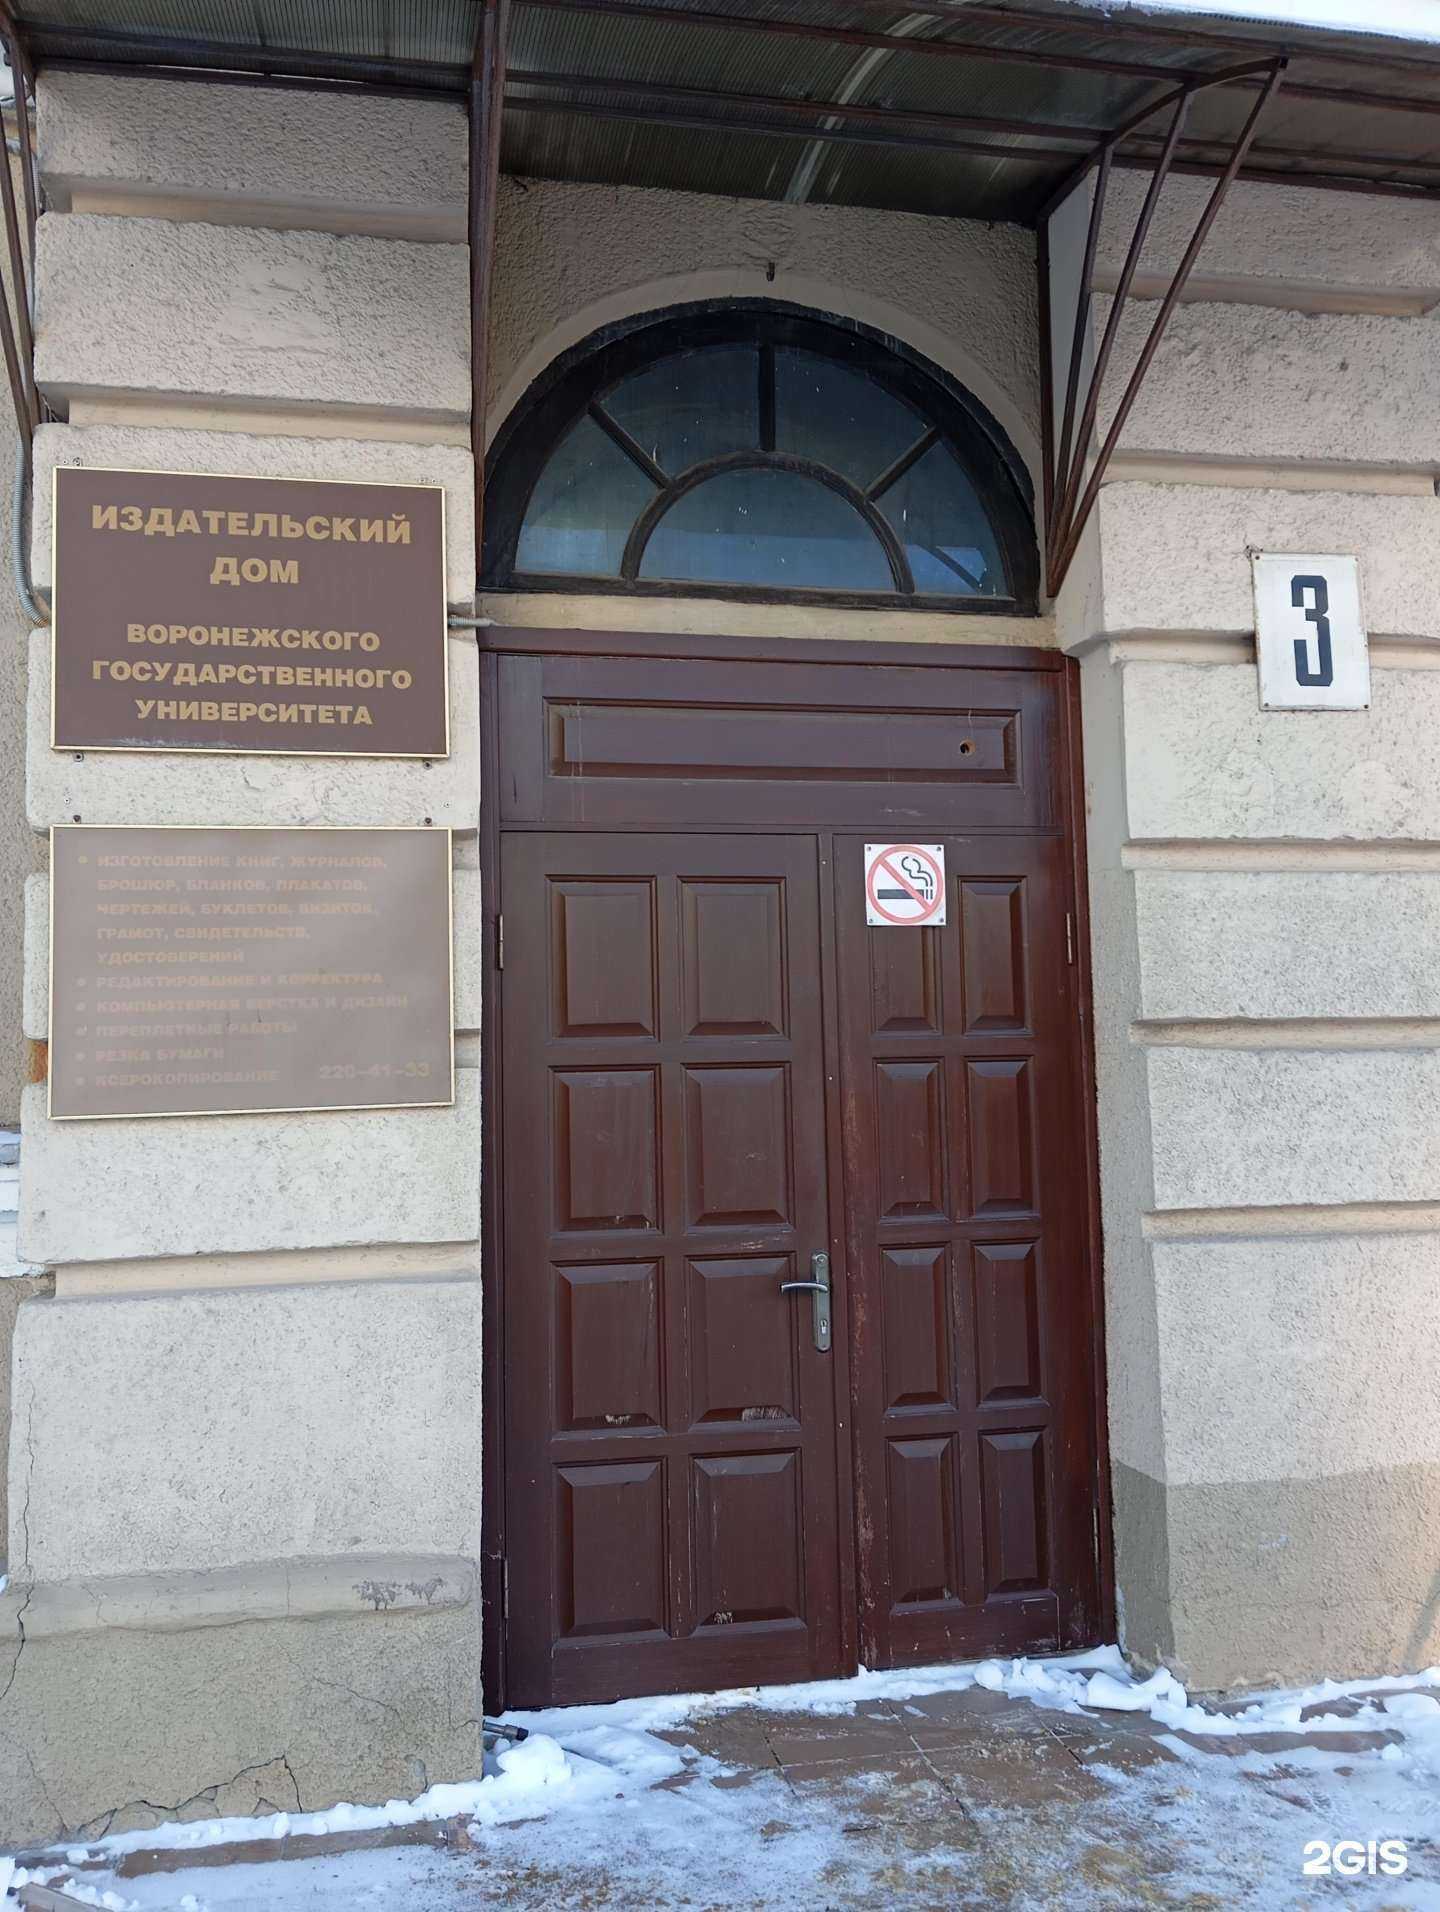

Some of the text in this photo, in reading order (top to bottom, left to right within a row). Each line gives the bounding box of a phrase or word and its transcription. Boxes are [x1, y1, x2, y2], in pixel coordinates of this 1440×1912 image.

[91, 504, 412, 544] ИЗДАТЕЛЬСКИЙ
[209, 556, 300, 586] ДОМ
[126, 623, 381, 652] ВОРОНЕЖСКОГО
[1290, 574, 1334, 687] 3
[91, 660, 413, 690] ГОСУДАРСТВЕННОГО
[135, 699, 375, 726] УНИВЕРСИТЕТА
[96, 855, 233, 868] ИЗГОТОВЛЕНИЕ
[96, 949, 245, 966] УДОСТОВЕРЕНИЙ
[96, 975, 257, 989] РЕДАКТИРОВАНИЕ
[96, 999, 241, 1014] КОМПЬЮТЕРНАЯ
